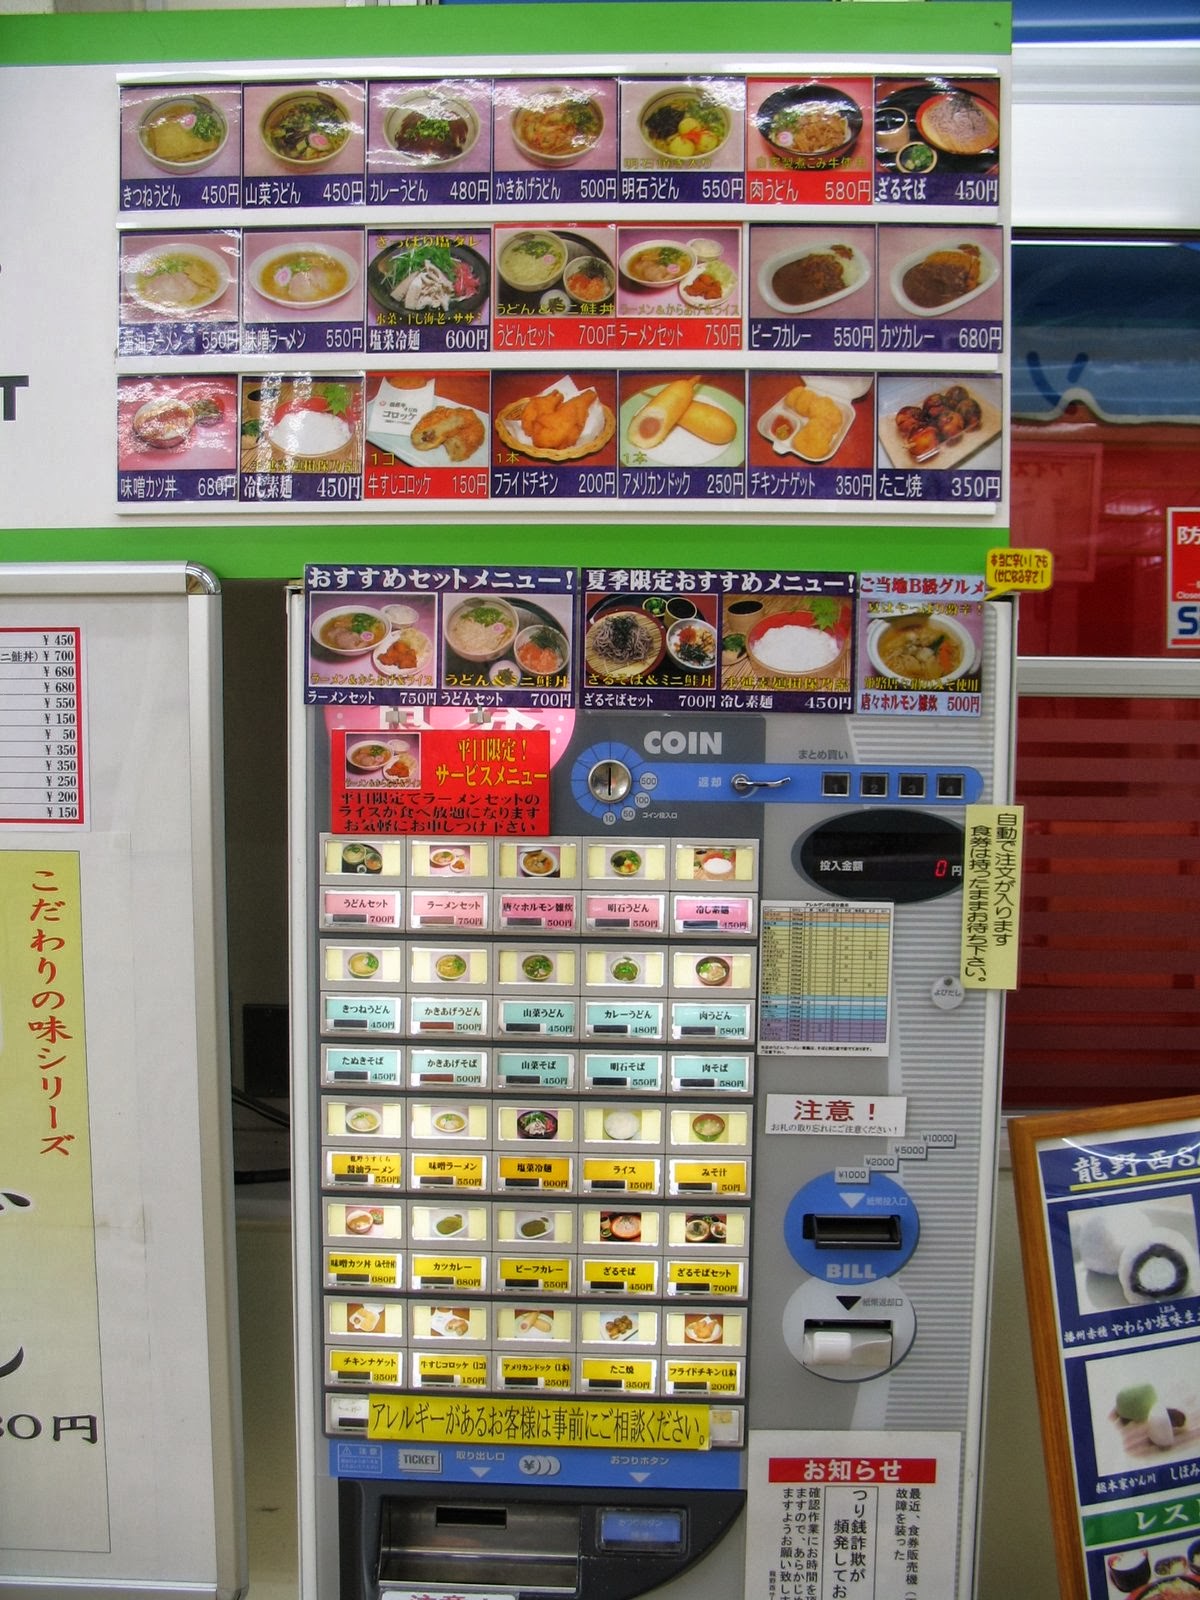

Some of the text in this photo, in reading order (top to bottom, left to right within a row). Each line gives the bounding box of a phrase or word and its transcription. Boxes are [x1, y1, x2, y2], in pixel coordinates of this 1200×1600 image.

[246, 182, 364, 204] 山菜うどん 450円
[370, 180, 489, 202] カレーうどん 480円
[496, 176, 617, 200] かきあげうどん 500円
[622, 177, 744, 201] 明石うどん 550円
[750, 179, 871, 202] 肉うどん 580円
[876, 177, 998, 201] ざるそば 450円
[123, 184, 239, 207] きつねうどん 450円
[246, 328, 362, 350] 味噌ラーメン 550円
[370, 329, 488, 350] 塩菜冷麺 600円
[498, 325, 615, 347] うどんセット 700円
[620, 325, 740, 346] ラーメンセット 750円
[751, 324, 874, 348] ビーフカレー 550円
[881, 324, 1001, 348] カツカレー 680円
[496, 451, 520, 464] 1本
[622, 451, 647, 465] 1本
[121, 475, 237, 498] 味噌カツ丼 680円
[317, 476, 360, 499] 450円
[368, 474, 488, 496] 牛すじコロッケ 150円
[494, 471, 616, 496] フライドチキン 200円
[622, 471, 744, 496] アメリカンドック 250円
[751, 471, 873, 496] チキンナゲット 350円
[880, 472, 1000, 498] たこ焼 350円
[308, 567, 573, 590] おすすめセットメニュー！
[587, 569, 855, 593] 夏季限定おすすめメニュー！
[860, 577, 984, 595] ご当地B級グルメ
[308, 690, 437, 705] ラーメンセット 750円
[442, 691, 572, 707] うどんセット 700円
[584, 693, 716, 708] ざるそばセット 700円
[721, 694, 852, 710] 冷し素麺 450円
[947, 696, 980, 713] 500円
[643, 730, 722, 755] COIN
[458, 737, 527, 762] 平日限定！
[798, 750, 848, 760] まとめ買い
[436, 765, 548, 787] サービスメニュー
[641, 777, 657, 785] 500
[341, 792, 540, 806] 平日限定でラーメンセットの
[339, 806, 540, 819] ライスが食べ放題になります
[345, 820, 535, 833] お気軽にお申しつけ下さい
[820, 858, 962, 877] 投入金額 0 円
[993, 813, 1018, 947] 自動で注文が入ります
[344, 898, 388, 908] うどんセット
[427, 900, 480, 910] ラーメンセット
[503, 903, 573, 912] 唐々ホルモン雑炊
[608, 903, 649, 913] 明石うどん
[965, 825, 993, 982] 食券は持ったままお待ち下さい。
[696, 906, 729, 915] 冷し素麺
[934, 988, 961, 997] よびだし
[28, 870, 75, 1156] こだわりの味シリーズ
[342, 1005, 390, 1014] きつねうどん
[424, 1006, 481, 1016] かきあげうどん
[523, 1008, 565, 1018] 山菜うどん
[604, 1010, 652, 1019] カレーうどん
[700, 1011, 732, 1020] 肉うどん
[342, 1056, 384, 1066] たぬきそば
[427, 1058, 477, 1068] かきあげそば
[521, 1060, 557, 1070] 山菜そば
[610, 1062, 645, 1071] 明石そば
[702, 1064, 728, 1073] 肉そば
[794, 1099, 875, 1122] 注意！
[923, 1134, 953, 1143] ¥10000
[895, 1146, 925, 1155] ¥5000
[429, 1161, 477, 1171] 味噌ラーメン
[517, 1163, 552, 1173] 塩菜冷麺
[866, 1158, 894, 1166] ¥2000
[347, 1165, 395, 1174] 醤油ラーメン
[613, 1166, 636, 1174] ライス
[702, 1168, 728, 1177] みそ汁
[838, 1170, 866, 1179] ¥1000
[331, 1259, 371, 1268] 味噌カツ丼
[433, 1263, 472, 1271] カツカレー
[516, 1265, 563, 1273] ビーフカレー
[603, 1267, 636, 1275] ざるそば
[677, 1268, 731, 1278] ざるそばセット
[826, 1264, 877, 1278] BILL
[713, 1285, 738, 1293] 700円
[344, 1357, 396, 1367] チキンナゲット
[421, 1360, 468, 1369] 牛すじコロッケ
[504, 1363, 551, 1372] アメリカンドック
[610, 1365, 634, 1374] たこ焼
[670, 1367, 720, 1376] フライドチキン
[373, 1374, 397, 1382] 350円
[462, 1377, 485, 1385] 150円
[544, 1379, 569, 1387] 250円
[625, 1381, 650, 1389] 350円
[711, 1383, 736, 1391] 200円
[0, 1414, 98, 1445] 0円
[372, 1402, 705, 1446] アレルギーがあるお客様は事前にご相談ください。
[403, 1454, 435, 1465] TICKET
[456, 1450, 504, 1461] 取り出し口
[611, 1455, 669, 1466] おつりボタン
[804, 1459, 902, 1481] お知らせ
[1135, 1499, 1200, 1530] レス
[894, 1488, 908, 1561] 故障を装った
[850, 1490, 868, 1583] つり銭詐欺が
